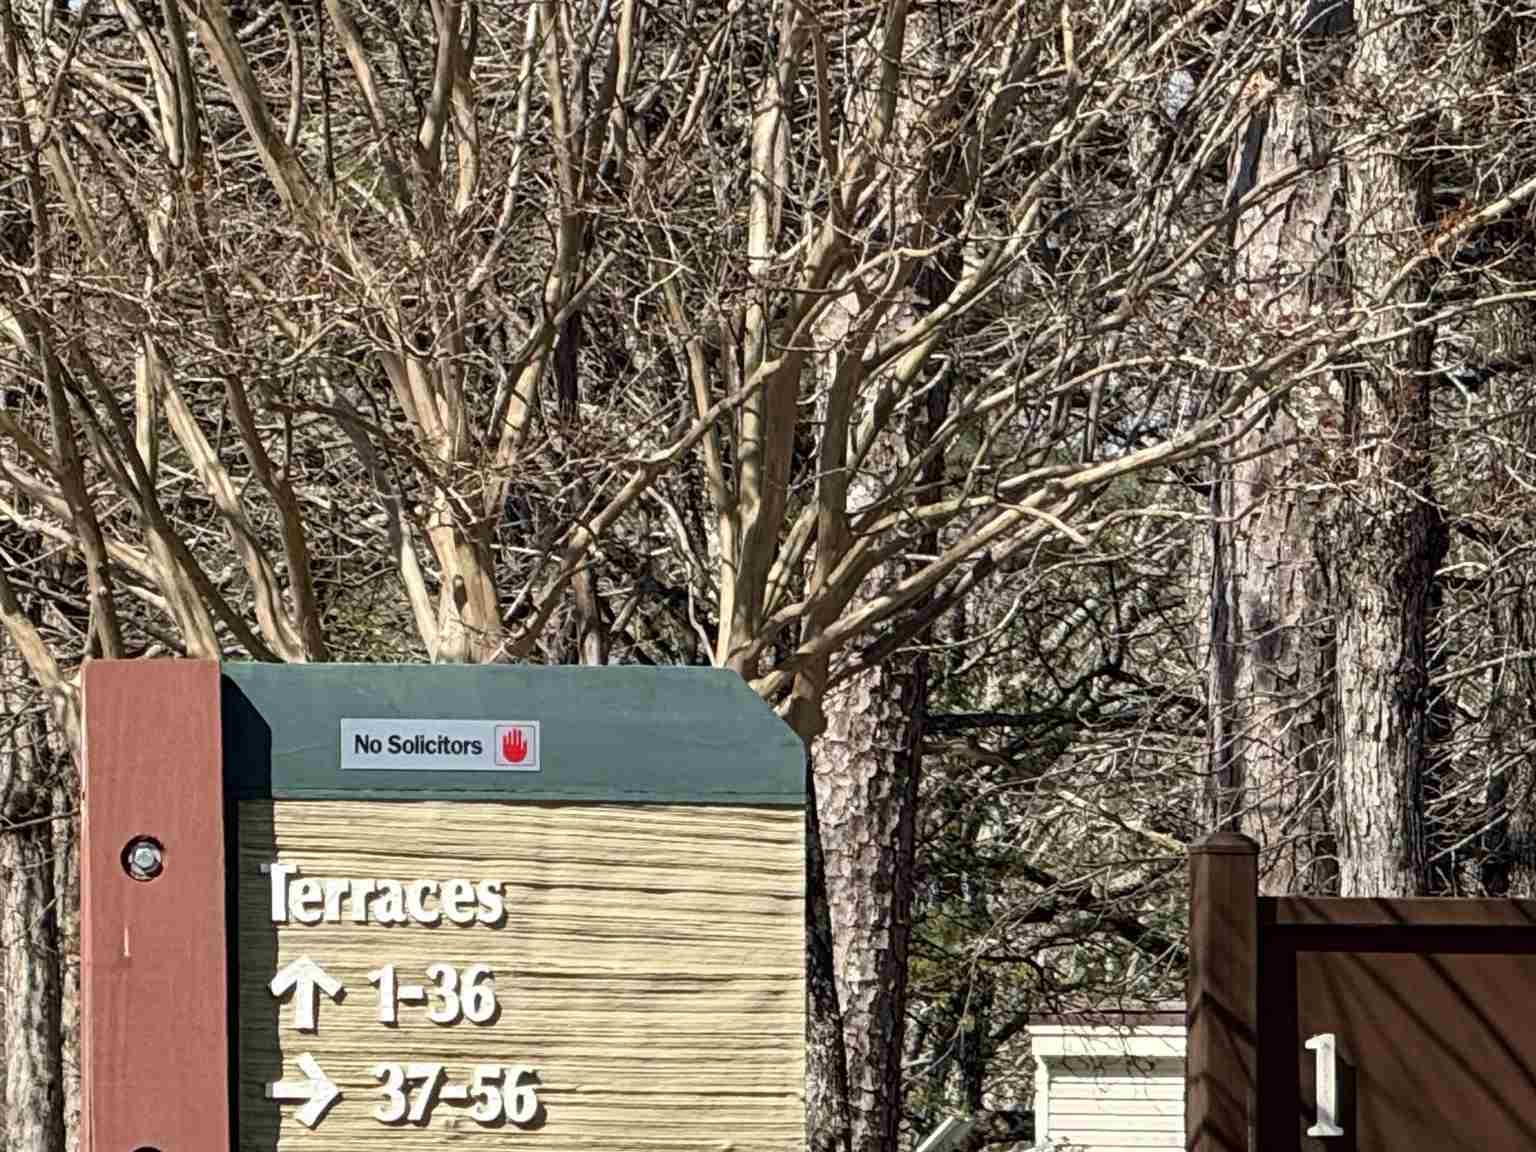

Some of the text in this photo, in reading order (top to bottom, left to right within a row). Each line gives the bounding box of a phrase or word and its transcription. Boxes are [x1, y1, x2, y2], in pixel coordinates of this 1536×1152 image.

[354, 734, 483, 755] No Solicitors
[260, 862, 506, 924] Terraces
[368, 964, 496, 1025] 1-36
[371, 1064, 538, 1124] 37-56
